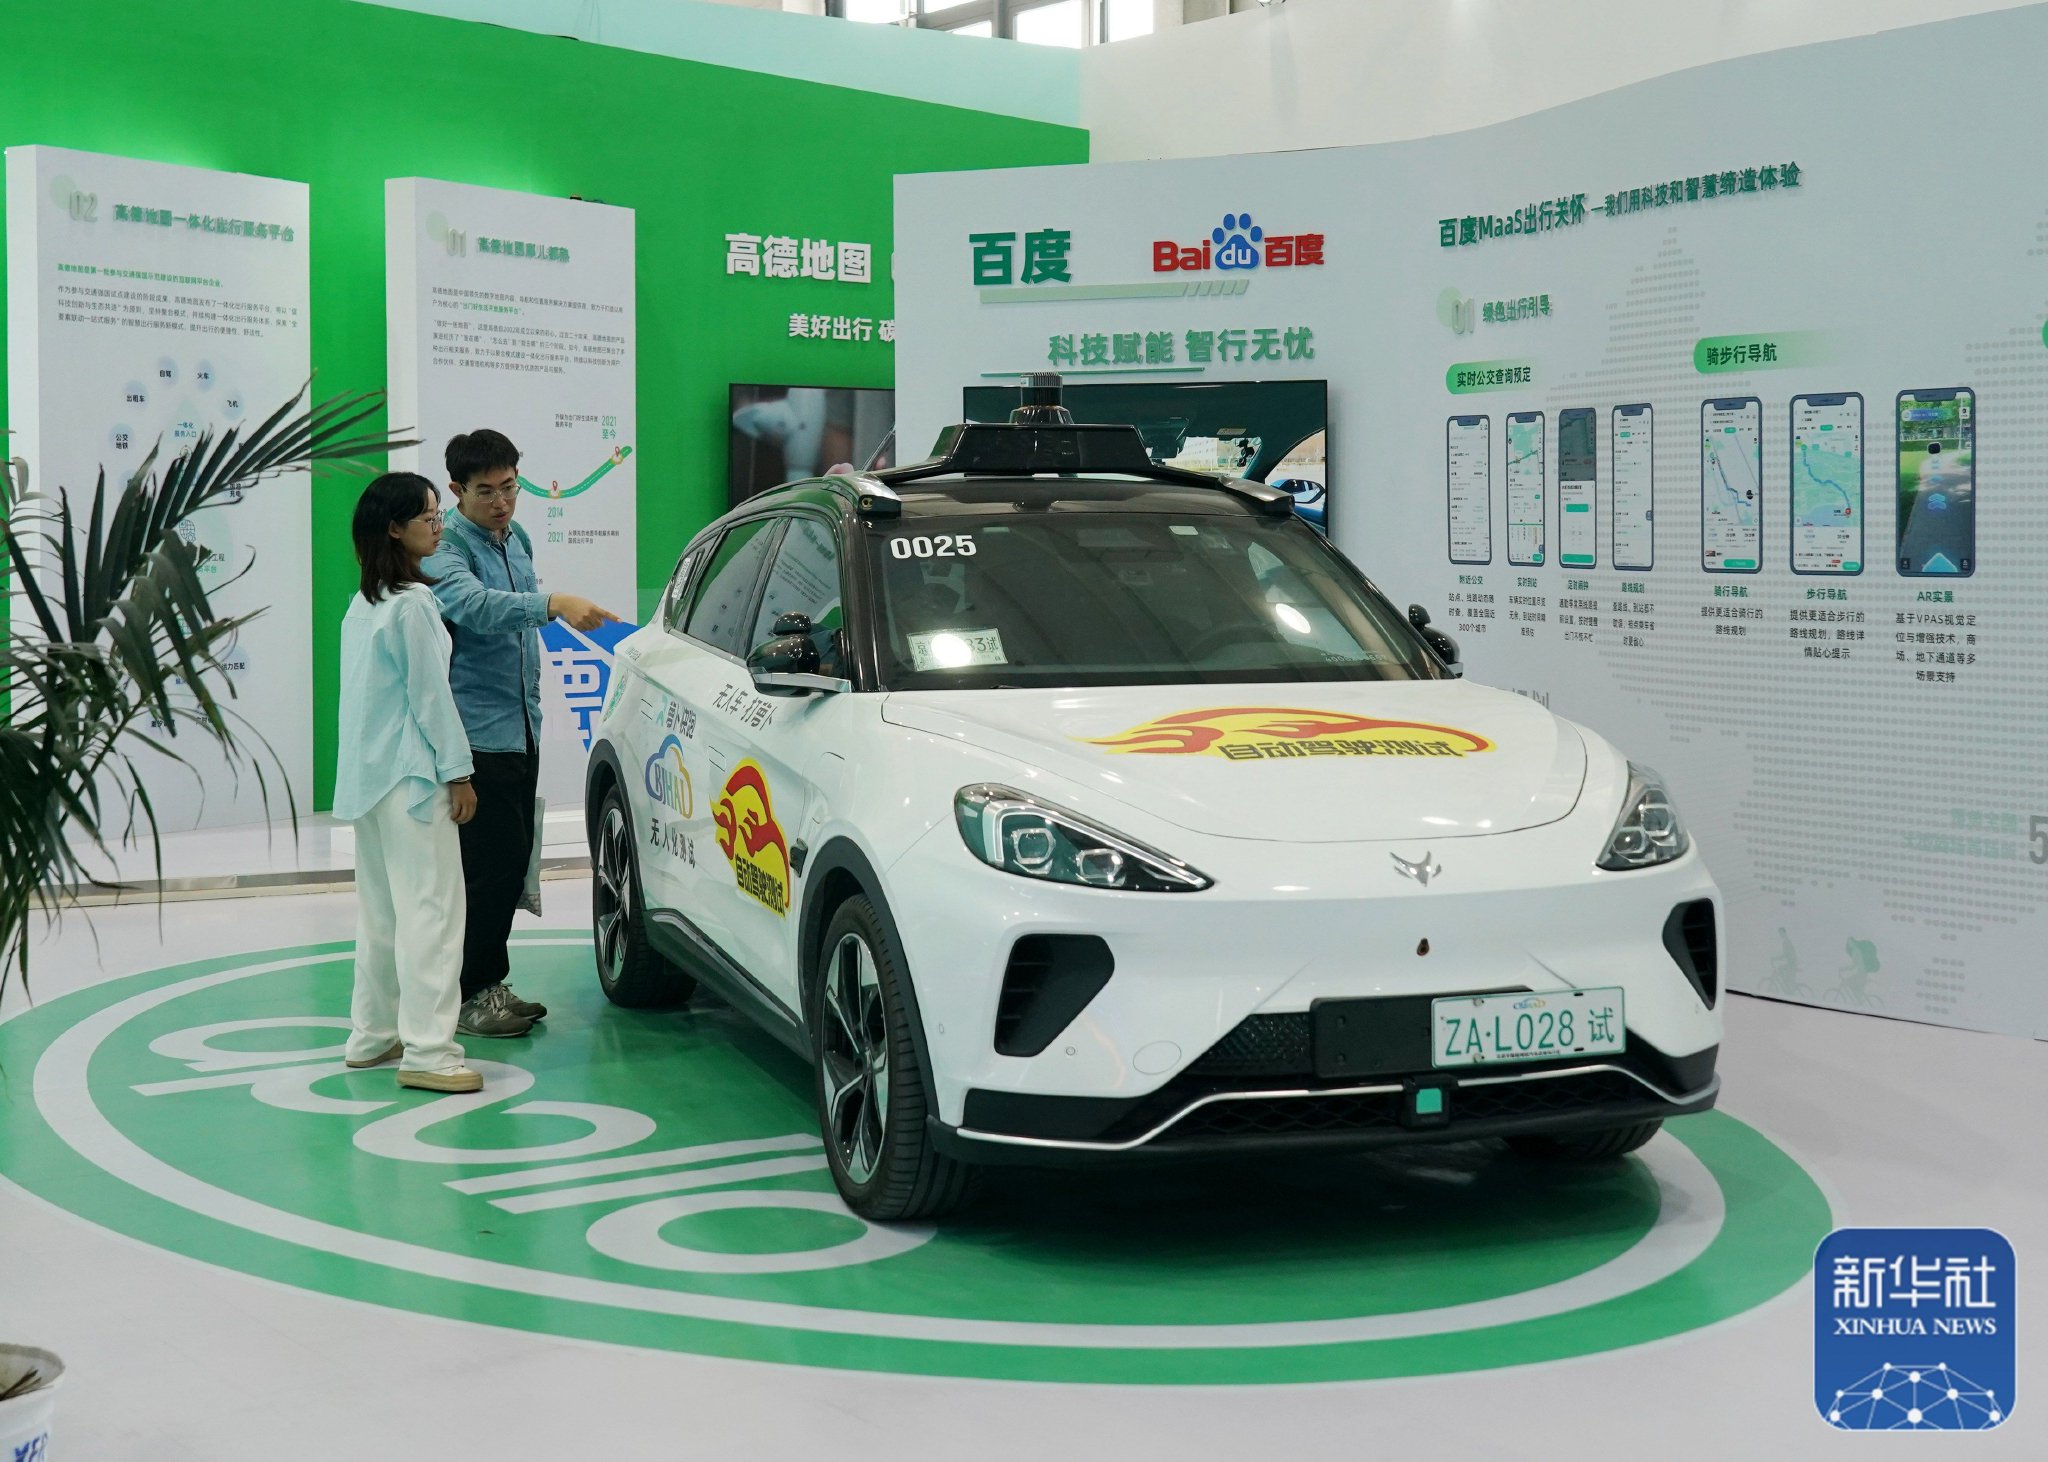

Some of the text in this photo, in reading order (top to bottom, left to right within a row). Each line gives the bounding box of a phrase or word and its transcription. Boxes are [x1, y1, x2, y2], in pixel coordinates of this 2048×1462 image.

[725, 233, 871, 283] 高德地图
[969, 228, 1072, 285] 百度
[1482, 294, 1552, 323] 绿色出行引导
[788, 313, 872, 341] 美好出行
[1047, 327, 1315, 366] 科技赋能 智行无忧
[1706, 342, 1777, 366] 骑步行导航
[197, 372, 209, 380] 火车
[1456, 366, 1531, 387] 实时公交查询预定
[227, 400, 239, 408] 飞机
[602, 416, 617, 427] 2021
[116, 434, 129, 442] 公交
[602, 429, 617, 439] 至今
[547, 507, 563, 518] 2014
[547, 532, 563, 543] 2021
[890, 535, 977, 559] 0025
[1458, 575, 1483, 585] 附近公交
[1714, 586, 1748, 598] 骑行导航
[1806, 588, 1848, 600] 步行导航
[1917, 590, 1953, 603] AR实景
[1701, 606, 1763, 619] 提供更适合骑行的
[1790, 610, 1865, 623] 提供更适合步行的
[1895, 613, 1976, 626] 基于VPAS视觉定
[1458, 624, 1487, 632] 300个城市
[1715, 625, 1746, 636] 路线规划
[1790, 628, 1865, 641] 路线规划，路线详
[1895, 632, 1976, 645] 位与增强技术，商
[1804, 647, 1850, 659] 情贴心提示
[1895, 650, 1976, 665] 场、地下通道等多
[1915, 670, 1955, 683] 场景支持
[1218, 740, 1463, 760] 自动驾驶测试
[735, 852, 785, 916] 自动驾驶测试
